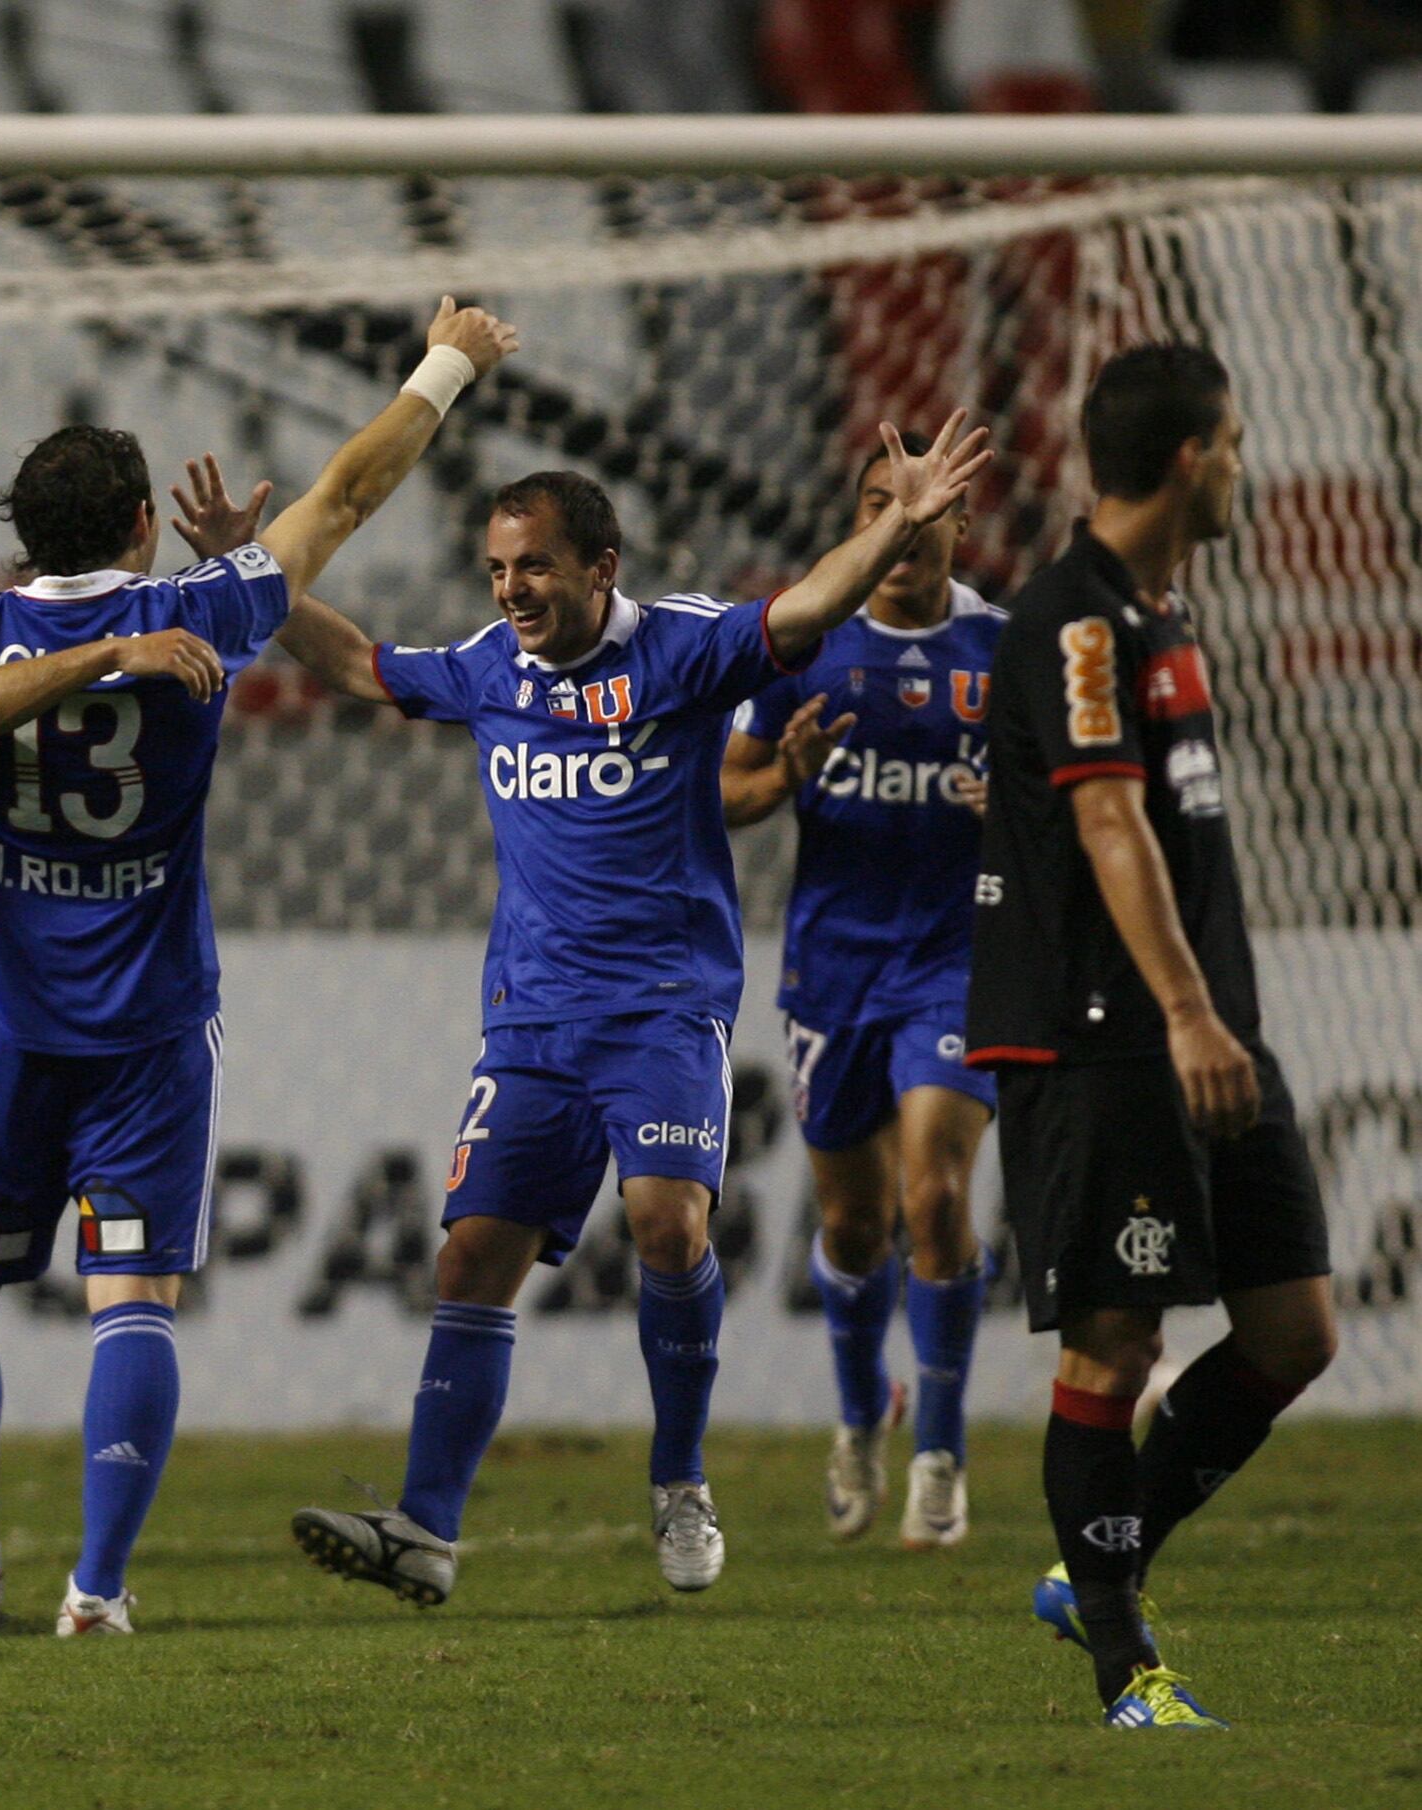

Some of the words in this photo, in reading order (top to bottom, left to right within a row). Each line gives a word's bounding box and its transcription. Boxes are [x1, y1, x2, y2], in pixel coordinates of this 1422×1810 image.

[582, 674, 633, 725] U
[949, 668, 992, 723] U
[1062, 617, 1121, 745] BMG
[7, 691, 145, 839] 13
[490, 743, 634, 799] Claro
[454, 1075, 497, 1141] 2
[638, 1119, 712, 1151] Claro
